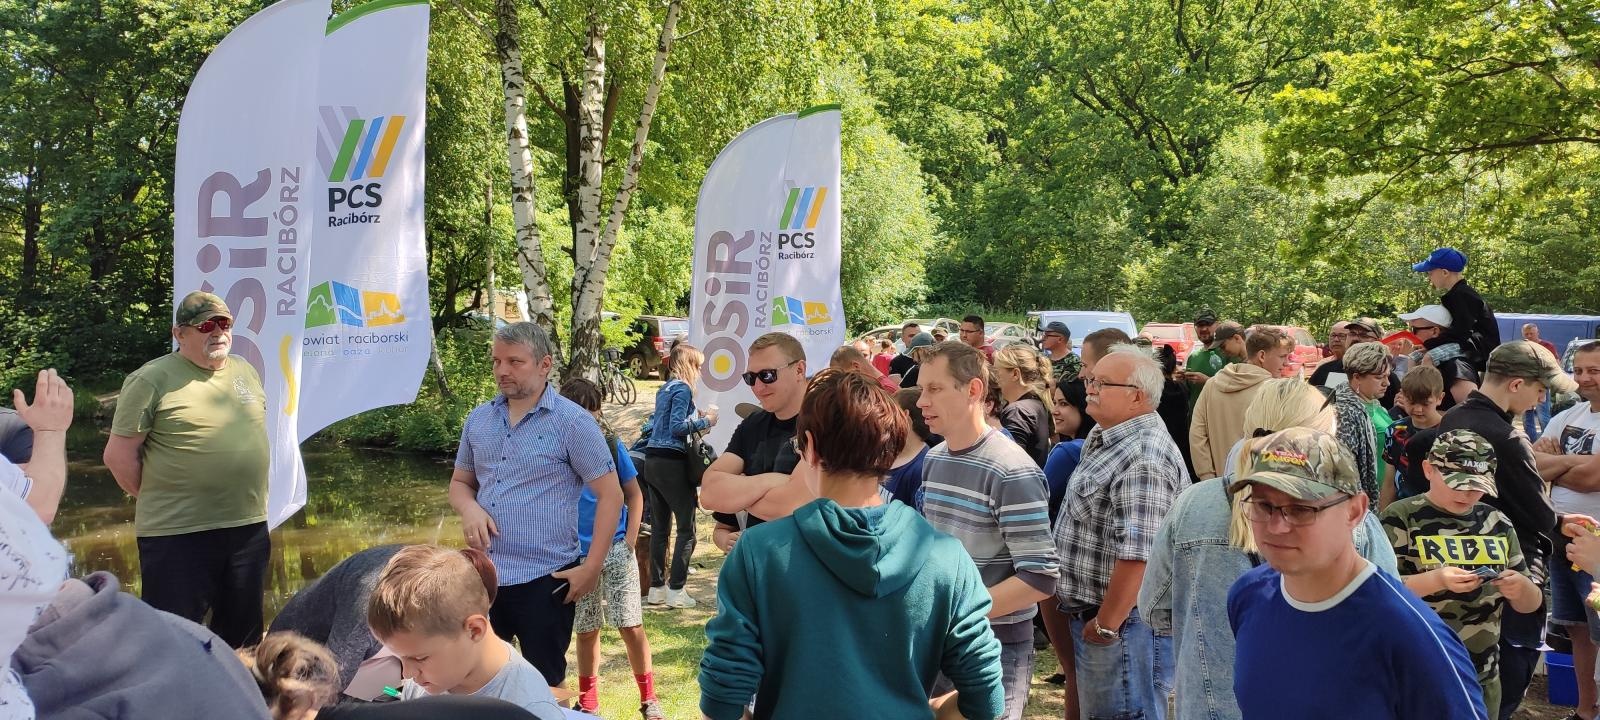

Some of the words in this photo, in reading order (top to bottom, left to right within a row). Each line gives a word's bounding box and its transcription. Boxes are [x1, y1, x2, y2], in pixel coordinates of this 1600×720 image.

[328, 183, 382, 212] PCS
[328, 211, 381, 227] Racibórz
[276, 166, 300, 316] RACIBÓRZ
[778, 232, 815, 249] PCS
[778, 251, 815, 260] Racibórz
[755, 231, 772, 328] RACIBÓRZ
[701, 229, 755, 392] OSiR
[302, 333, 340, 346] owiat
[348, 331, 409, 344] raciborski
